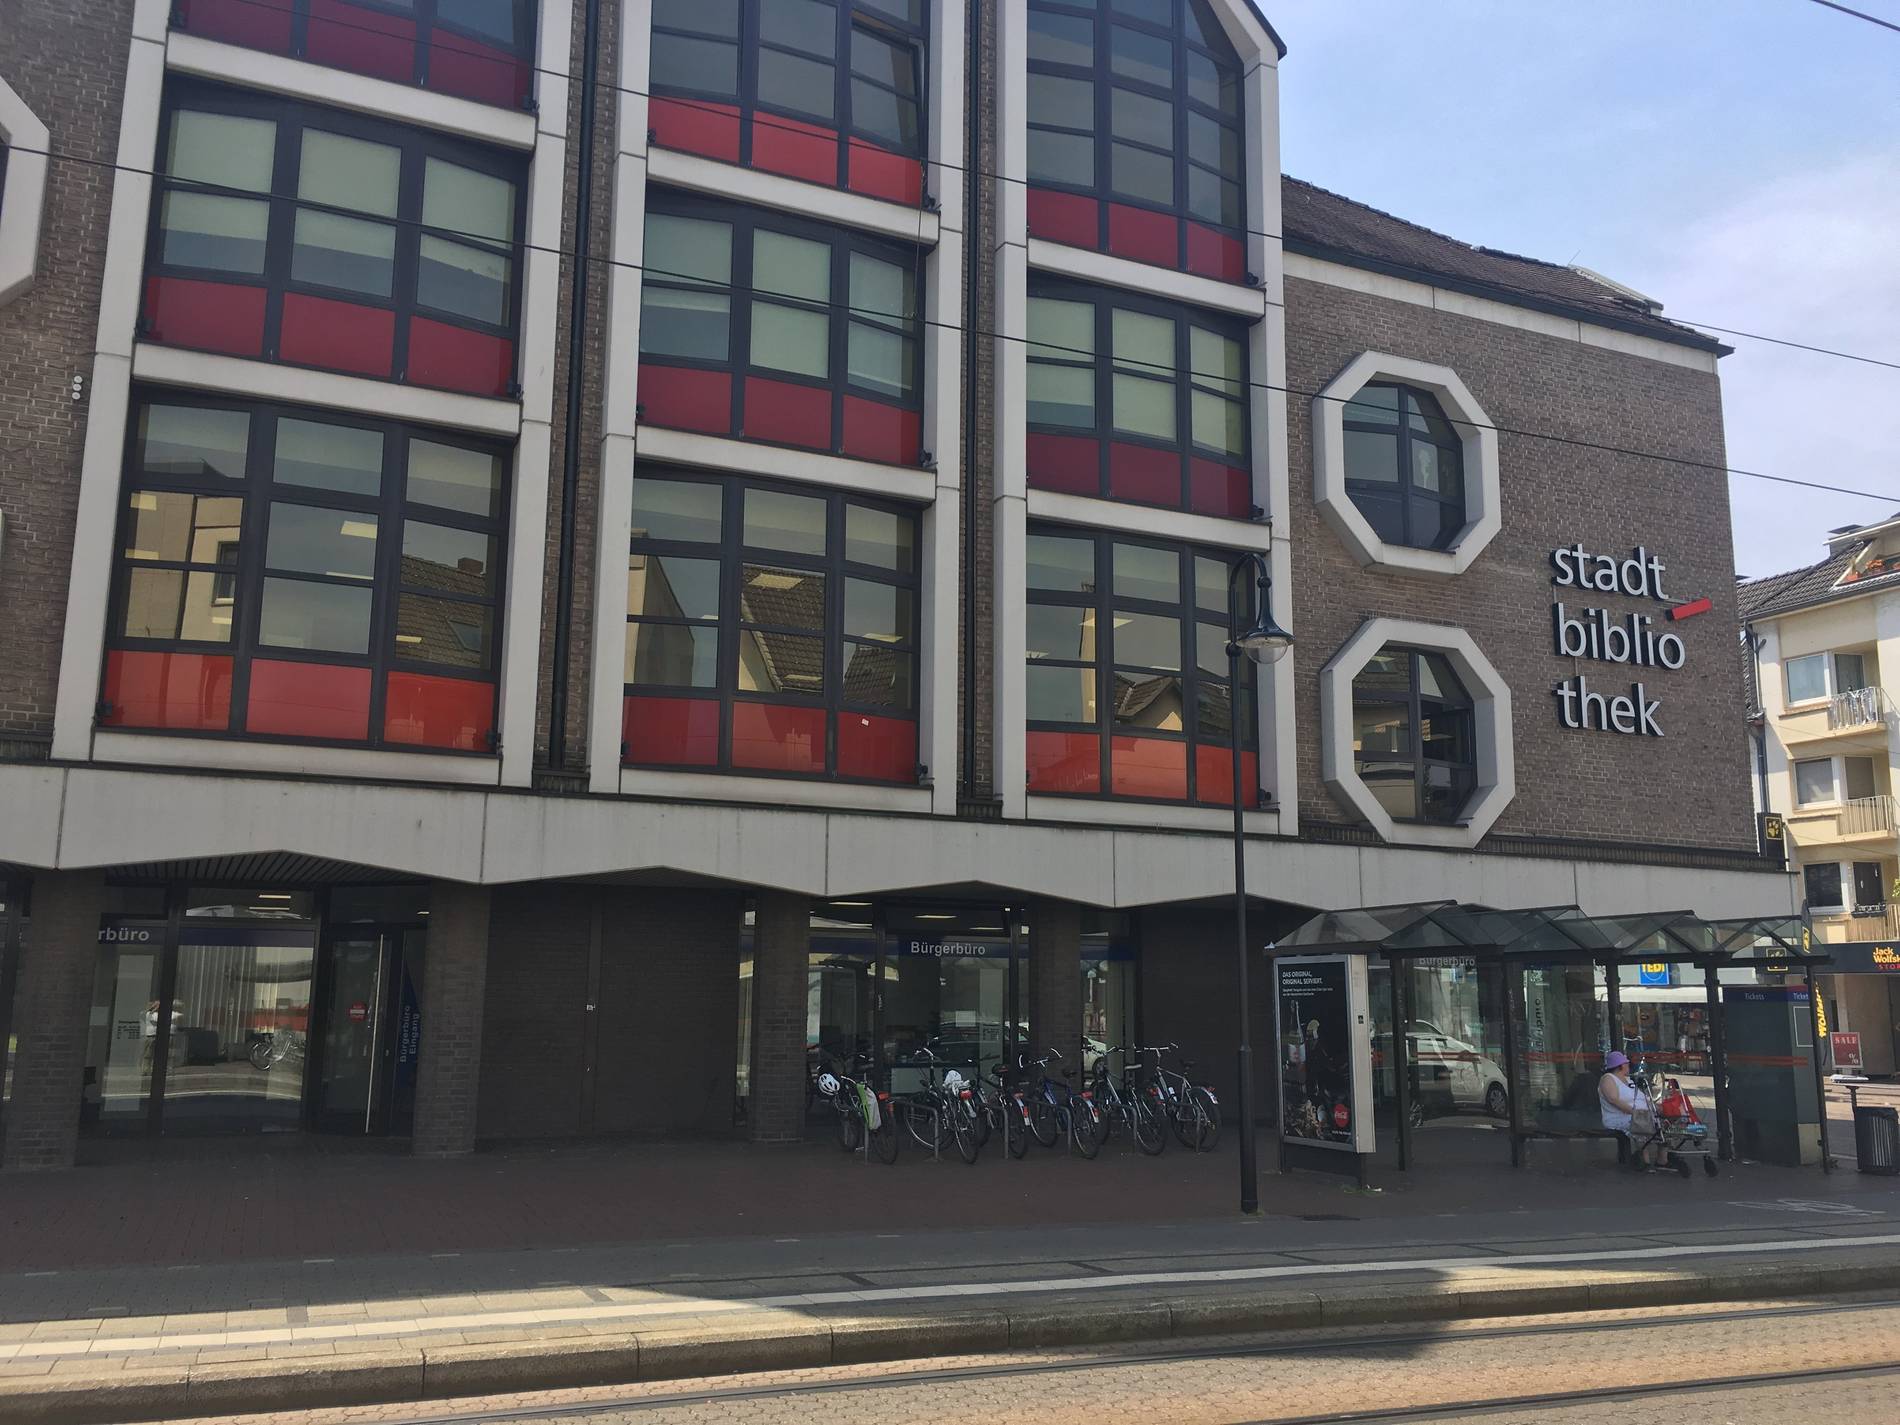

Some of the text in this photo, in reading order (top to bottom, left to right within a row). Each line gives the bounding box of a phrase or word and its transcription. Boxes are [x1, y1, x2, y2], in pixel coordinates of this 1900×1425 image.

[1553, 543, 1669, 600] stadt
[1556, 602, 1686, 670] biblio
[1556, 675, 1665, 737] thek
[911, 942, 986, 956] Bürgerbüro
[1872, 947, 1894, 955] Jack
[400, 1004, 411, 1062] Bürgerbüro
[409, 1012, 420, 1055] Eingang
[1834, 1036, 1857, 1044] SALE
